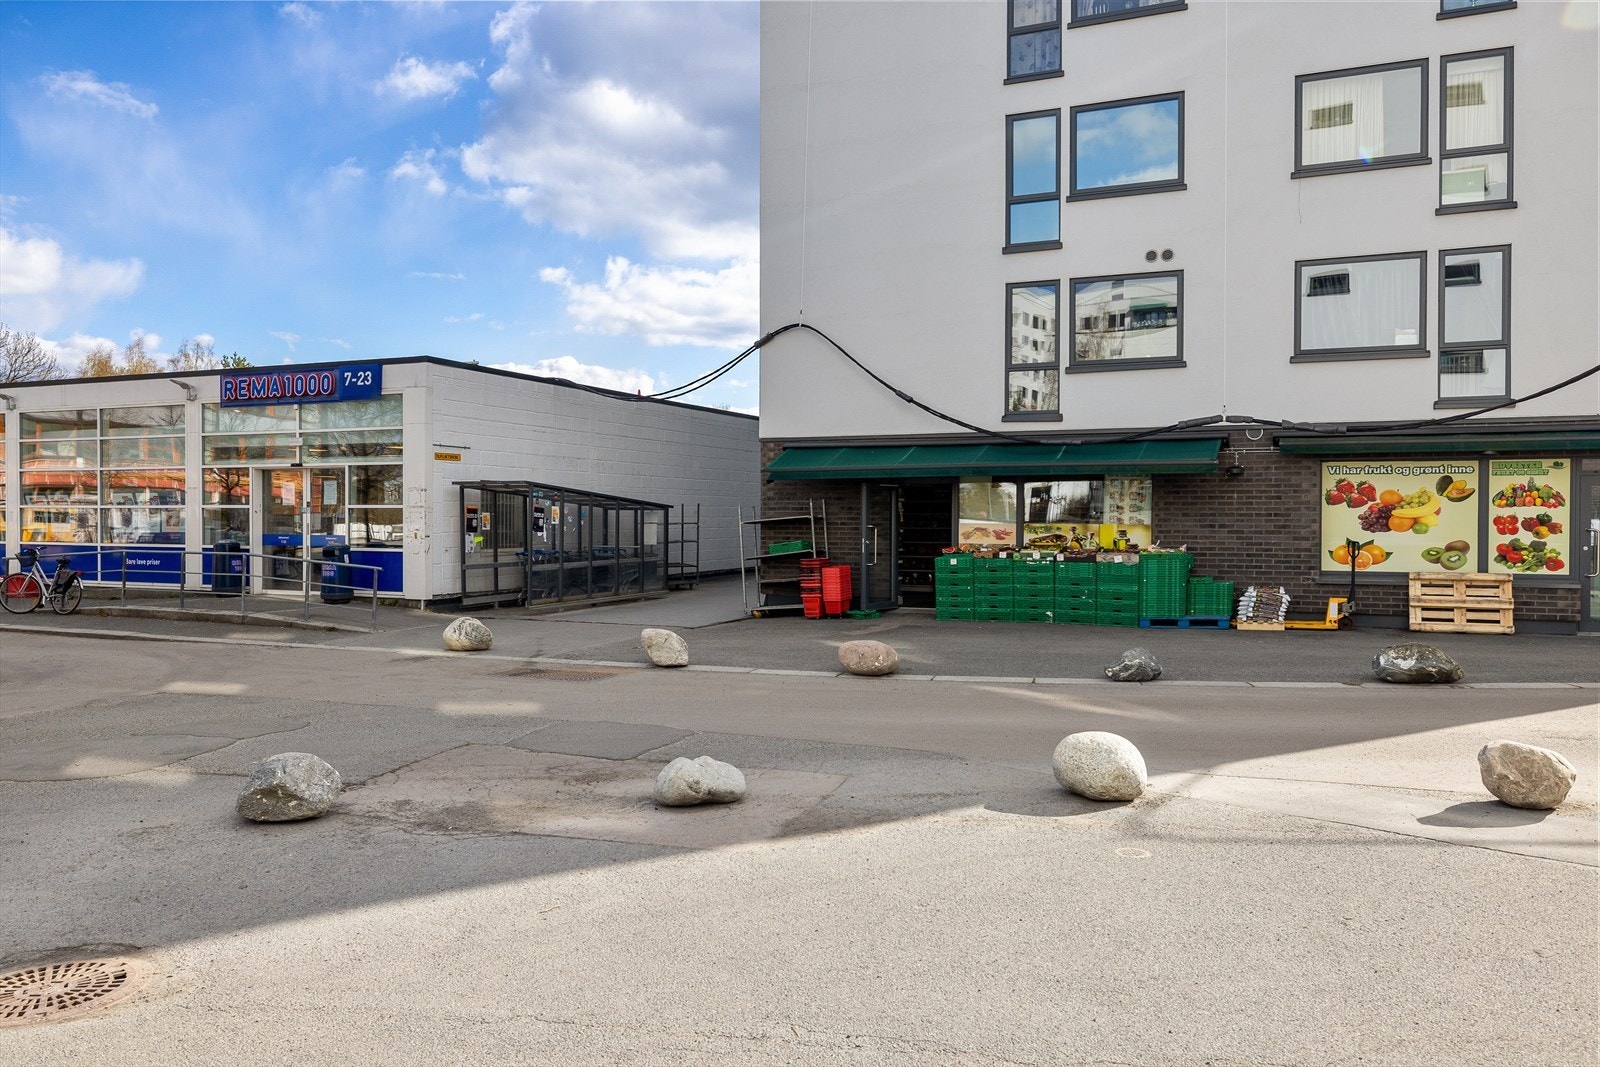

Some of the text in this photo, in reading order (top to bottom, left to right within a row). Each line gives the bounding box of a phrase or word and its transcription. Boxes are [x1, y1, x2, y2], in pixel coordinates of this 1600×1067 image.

[344, 371, 372, 386] 7-23
[1327, 464, 1475, 477] Vi har frukt og grønt inne
[147, 558, 161, 567] priser
